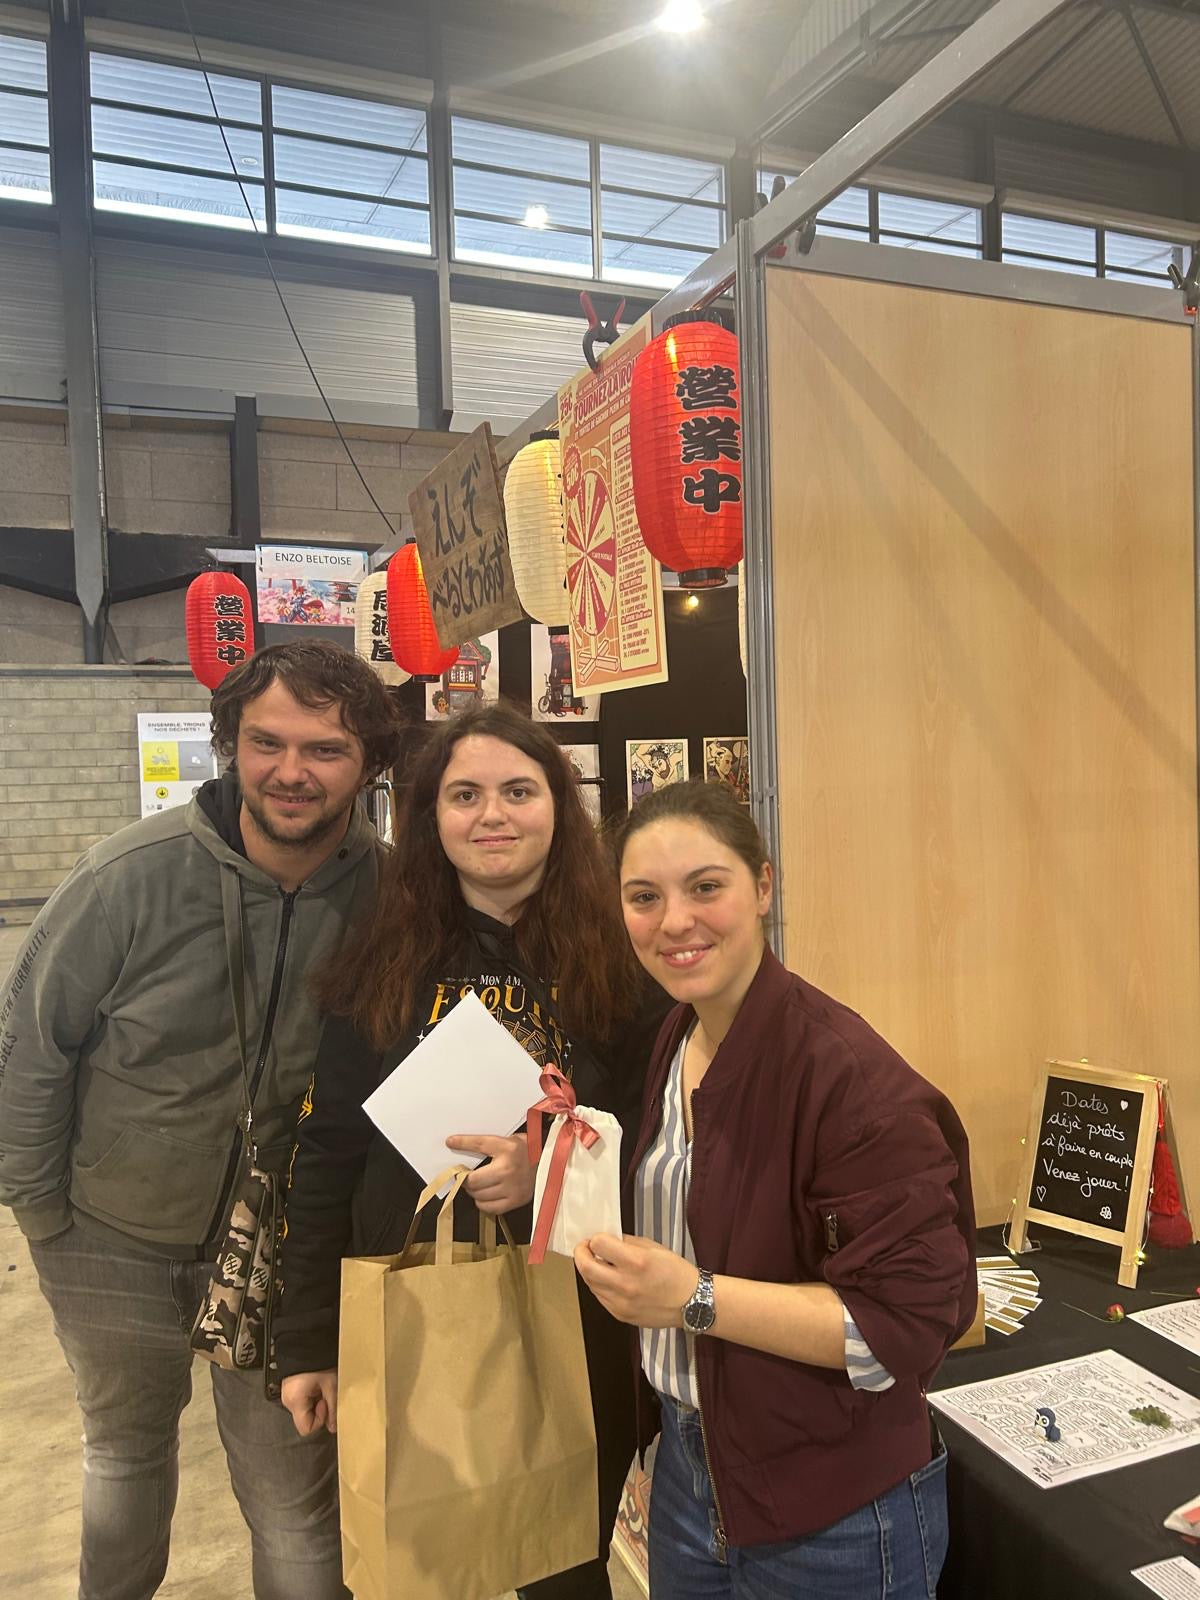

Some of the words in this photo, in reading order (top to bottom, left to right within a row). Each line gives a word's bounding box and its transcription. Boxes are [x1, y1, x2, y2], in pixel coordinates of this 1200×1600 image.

[574, 381, 608, 425] TOURNEZ
[607, 374, 620, 401] LA
[675, 364, 742, 514] 営業中
[275, 552, 303, 563] ENZO
[306, 554, 352, 566] BELTOISE
[214, 595, 246, 665] 営業中
[0, 995, 15, 1025] NEW
[11, 925, 50, 998] NORMALITY.
[480, 974, 502, 986] MON
[1061, 1091, 1109, 1114] Dates
[1046, 1112, 1082, 1134] déjà
[1087, 1123, 1125, 1141] prêts
[1041, 1133, 1056, 1147] à
[1057, 1135, 1087, 1157] faire
[1089, 1149, 1102, 1160] en
[1104, 1153, 1134, 1169] couple
[1043, 1158, 1081, 1182] Venez
